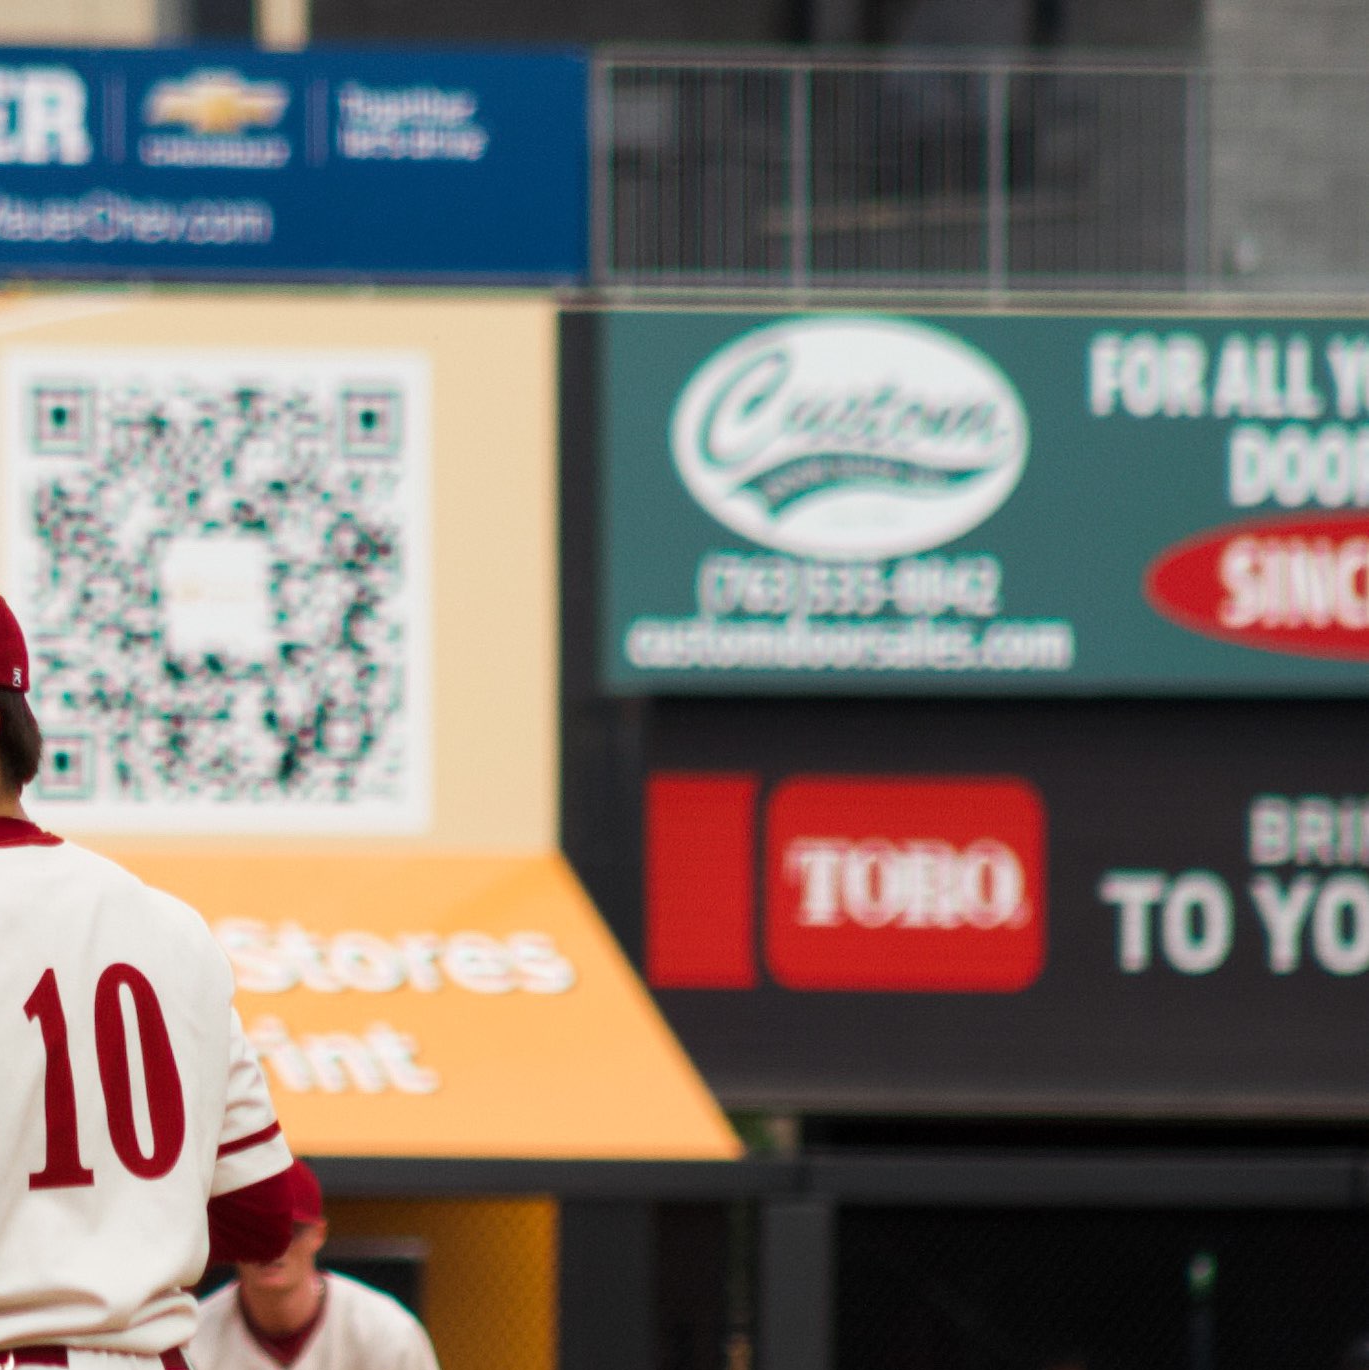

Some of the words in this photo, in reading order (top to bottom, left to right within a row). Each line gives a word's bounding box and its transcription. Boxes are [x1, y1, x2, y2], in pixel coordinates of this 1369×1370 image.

[695, 347, 1012, 469] Custom
[1089, 330, 1208, 419] FOR
[1212, 331, 1326, 420] ALL
[625, 616, 1075, 671] customdoorsales.com
[784, 837, 1026, 929] TORO
[1098, 868, 1234, 975] TO
[212, 915, 576, 994] Stores
[23, 962, 186, 1190] 10
